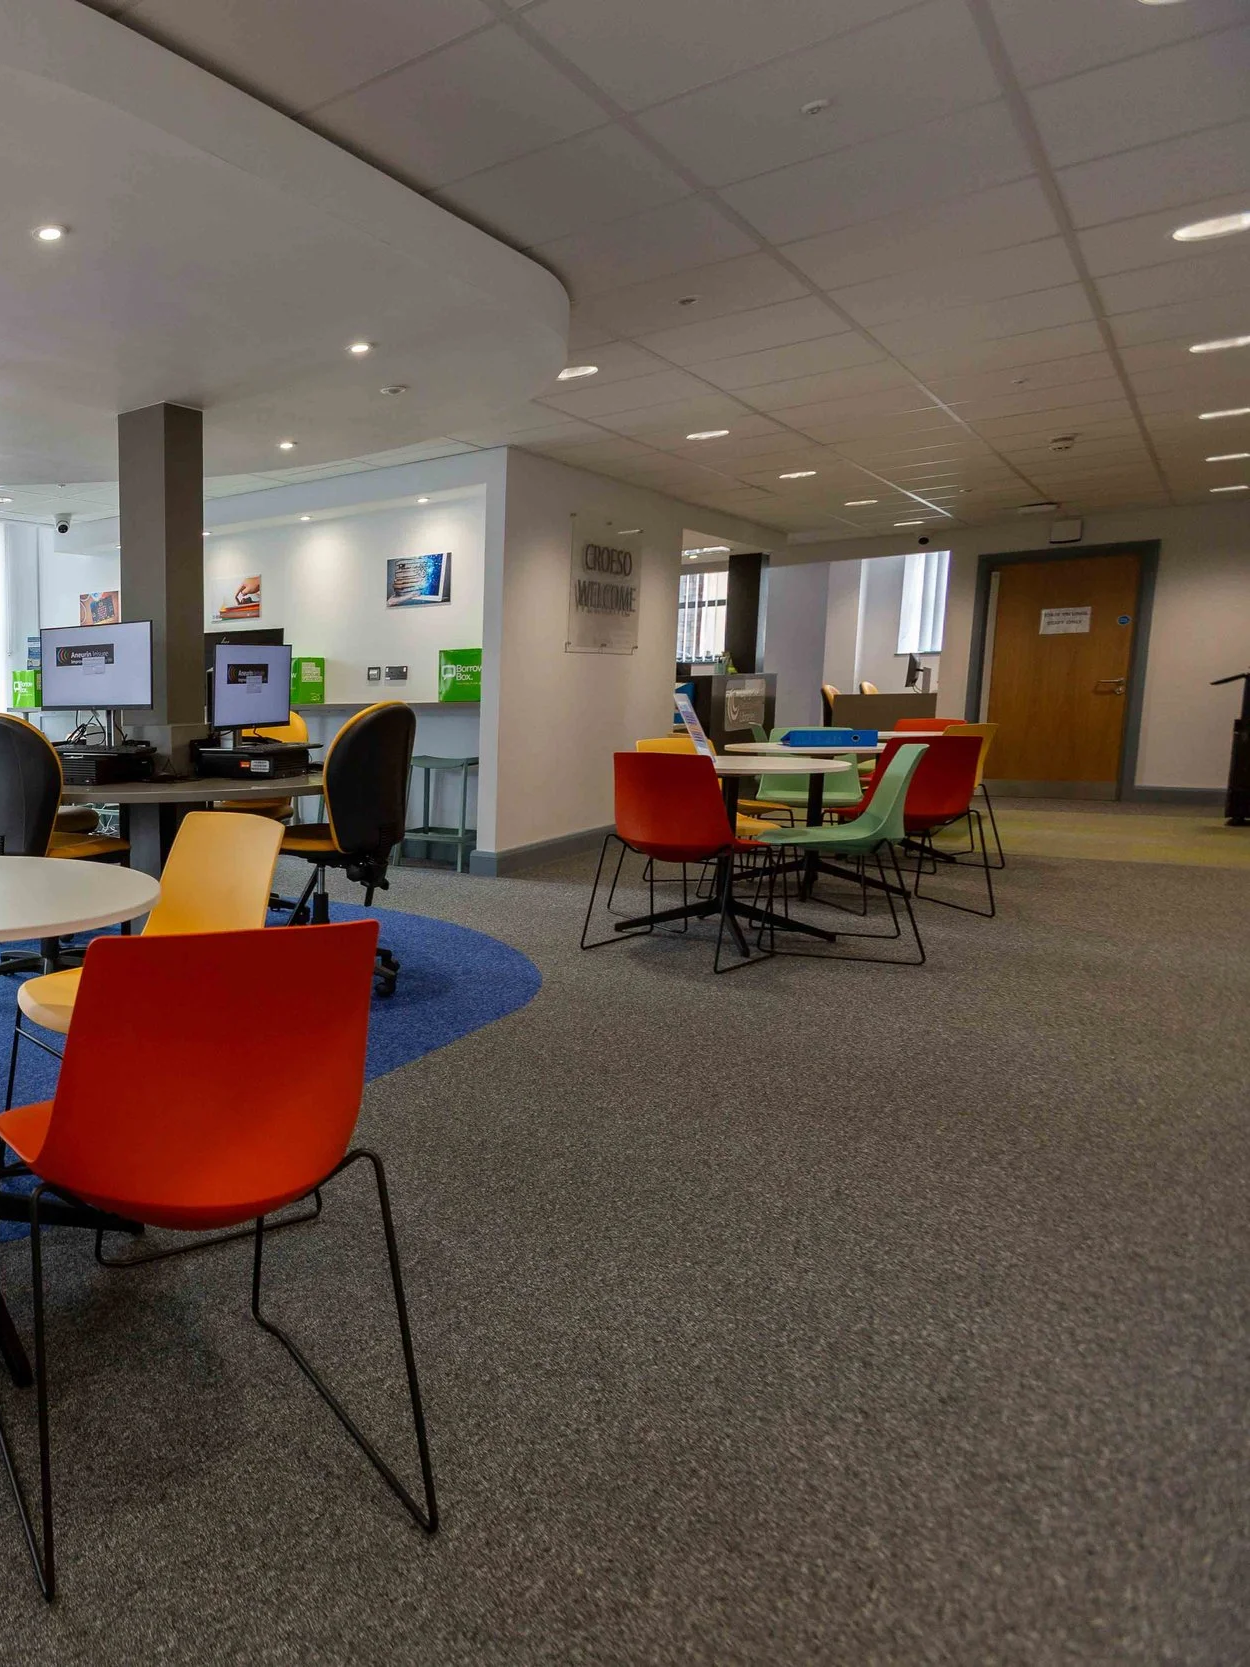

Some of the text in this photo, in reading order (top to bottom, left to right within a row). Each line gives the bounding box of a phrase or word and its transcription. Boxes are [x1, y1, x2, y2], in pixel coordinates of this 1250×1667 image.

[585, 543, 632, 577] CROESO
[577, 579, 636, 612] WELCOME
[71, 651, 92, 659] Aneurin
